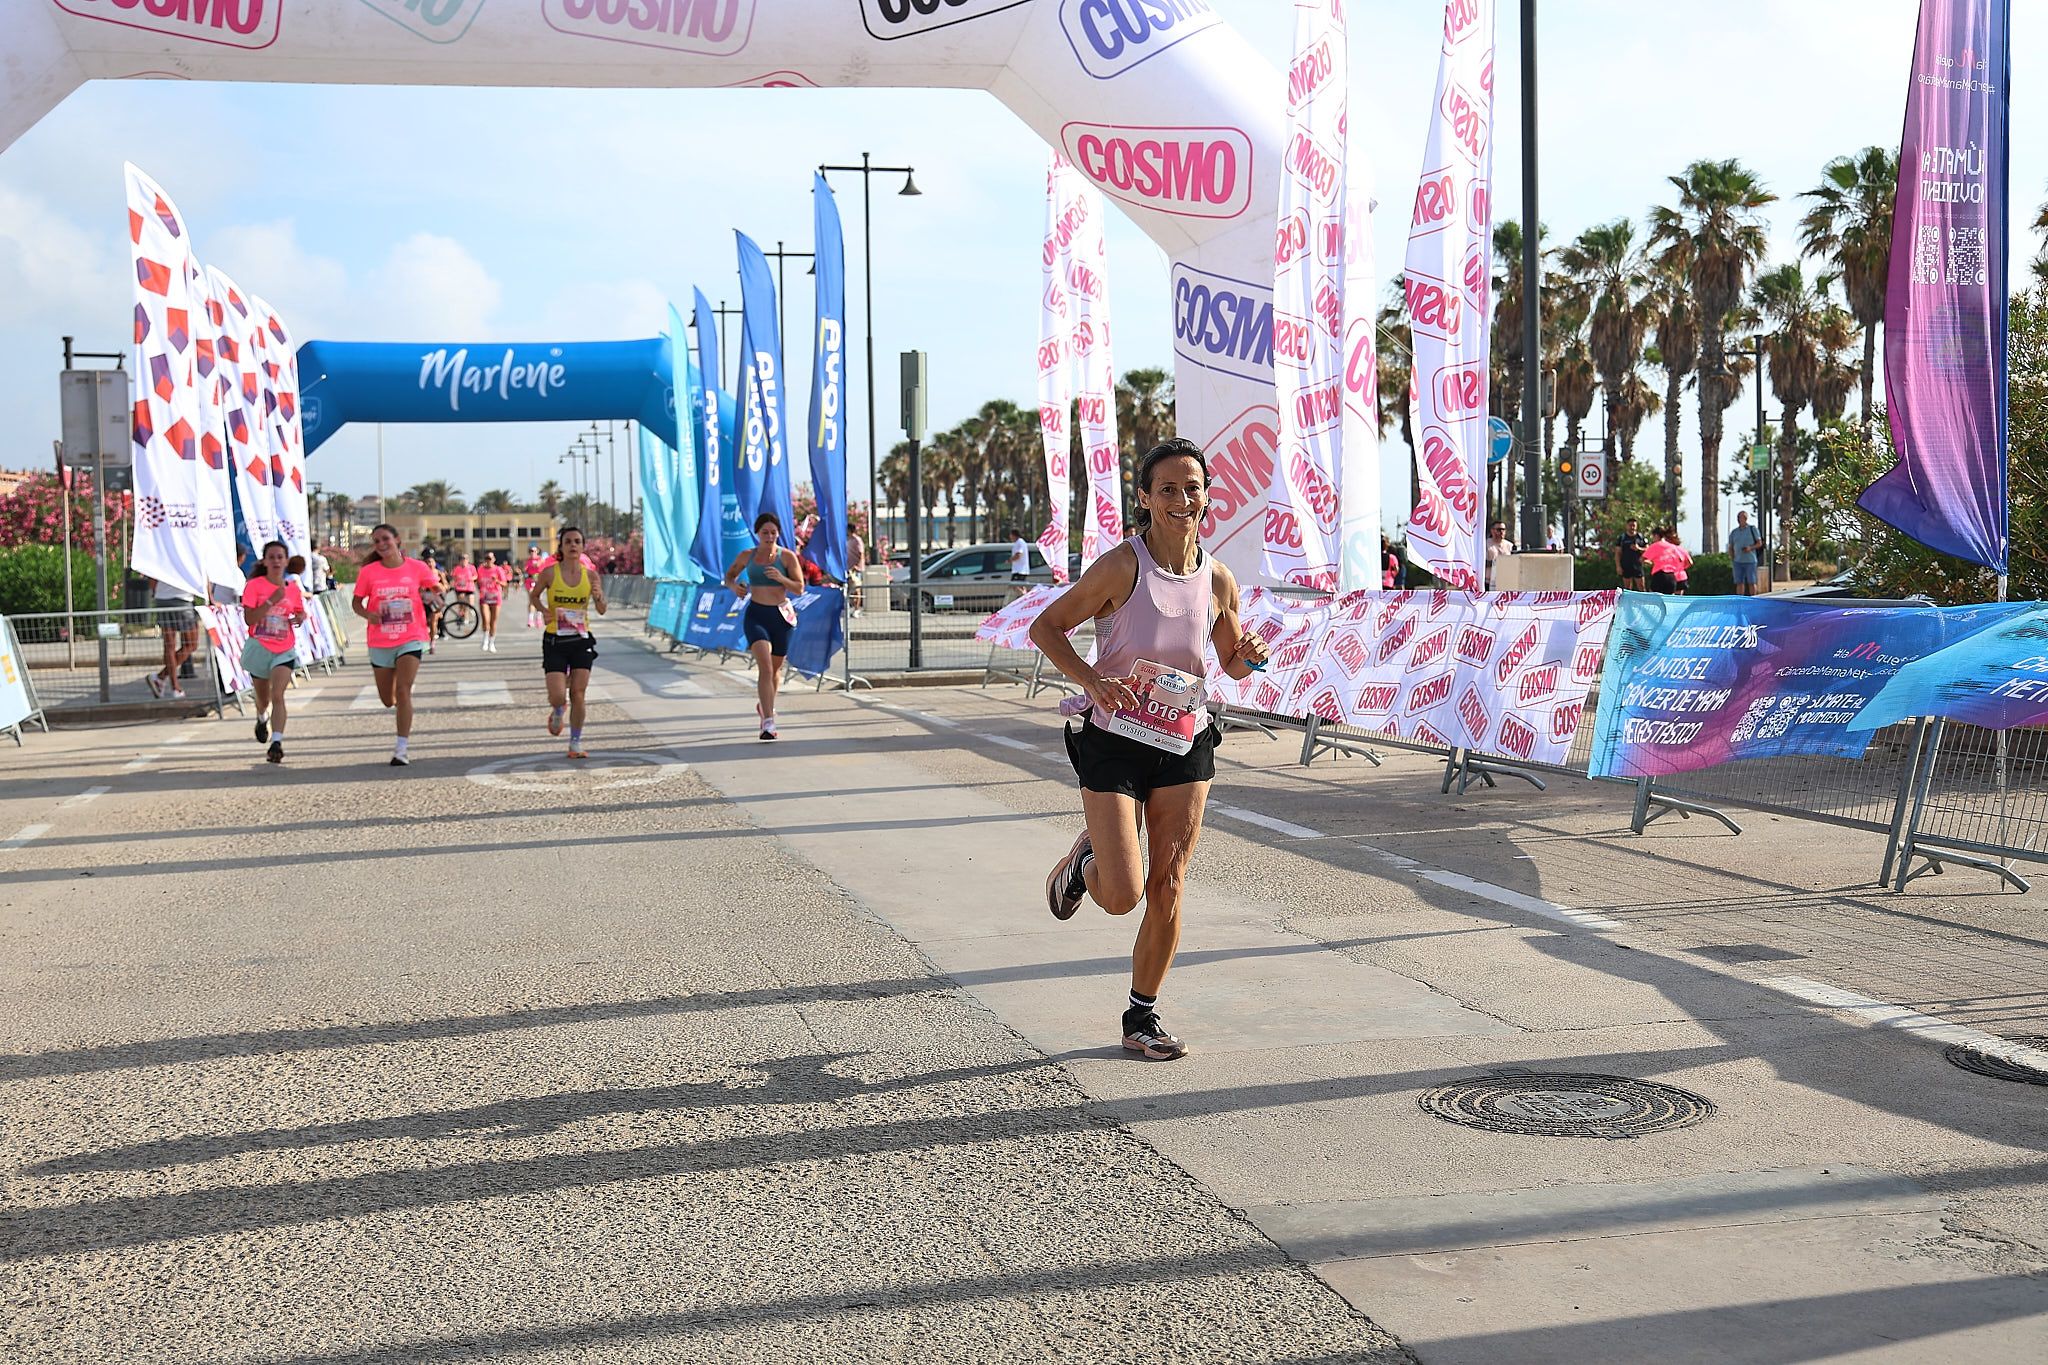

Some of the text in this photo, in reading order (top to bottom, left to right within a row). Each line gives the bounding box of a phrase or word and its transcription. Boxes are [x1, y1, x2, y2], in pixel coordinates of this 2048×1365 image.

[1077, 134, 1236, 204] COSMO
[1175, 281, 1275, 367] COSM
[418, 347, 566, 412] Marlene
[1585, 470, 1598, 479] 30
[1334, 633, 1367, 675] COSMO
[1379, 615, 1416, 662] COSMO
[1411, 628, 1448, 668] COSMO
[1458, 629, 1493, 663] COSMO
[1498, 624, 1537, 683] COSMO
[1519, 666, 1558, 701] COSMO
[1688, 657, 1713, 680] EL
[1147, 700, 1180, 722] 016
[1358, 686, 1398, 710] COSMO
[1409, 674, 1451, 712] COSMO
[1668, 688, 1699, 712] DE
[1690, 688, 1732, 713] MAMA
[1119, 723, 1147, 738] OYSHO
[1458, 688, 1488, 743] COSMO
[1622, 716, 1704, 745] METASTÁSICO
[1500, 718, 1535, 760] COSMO
